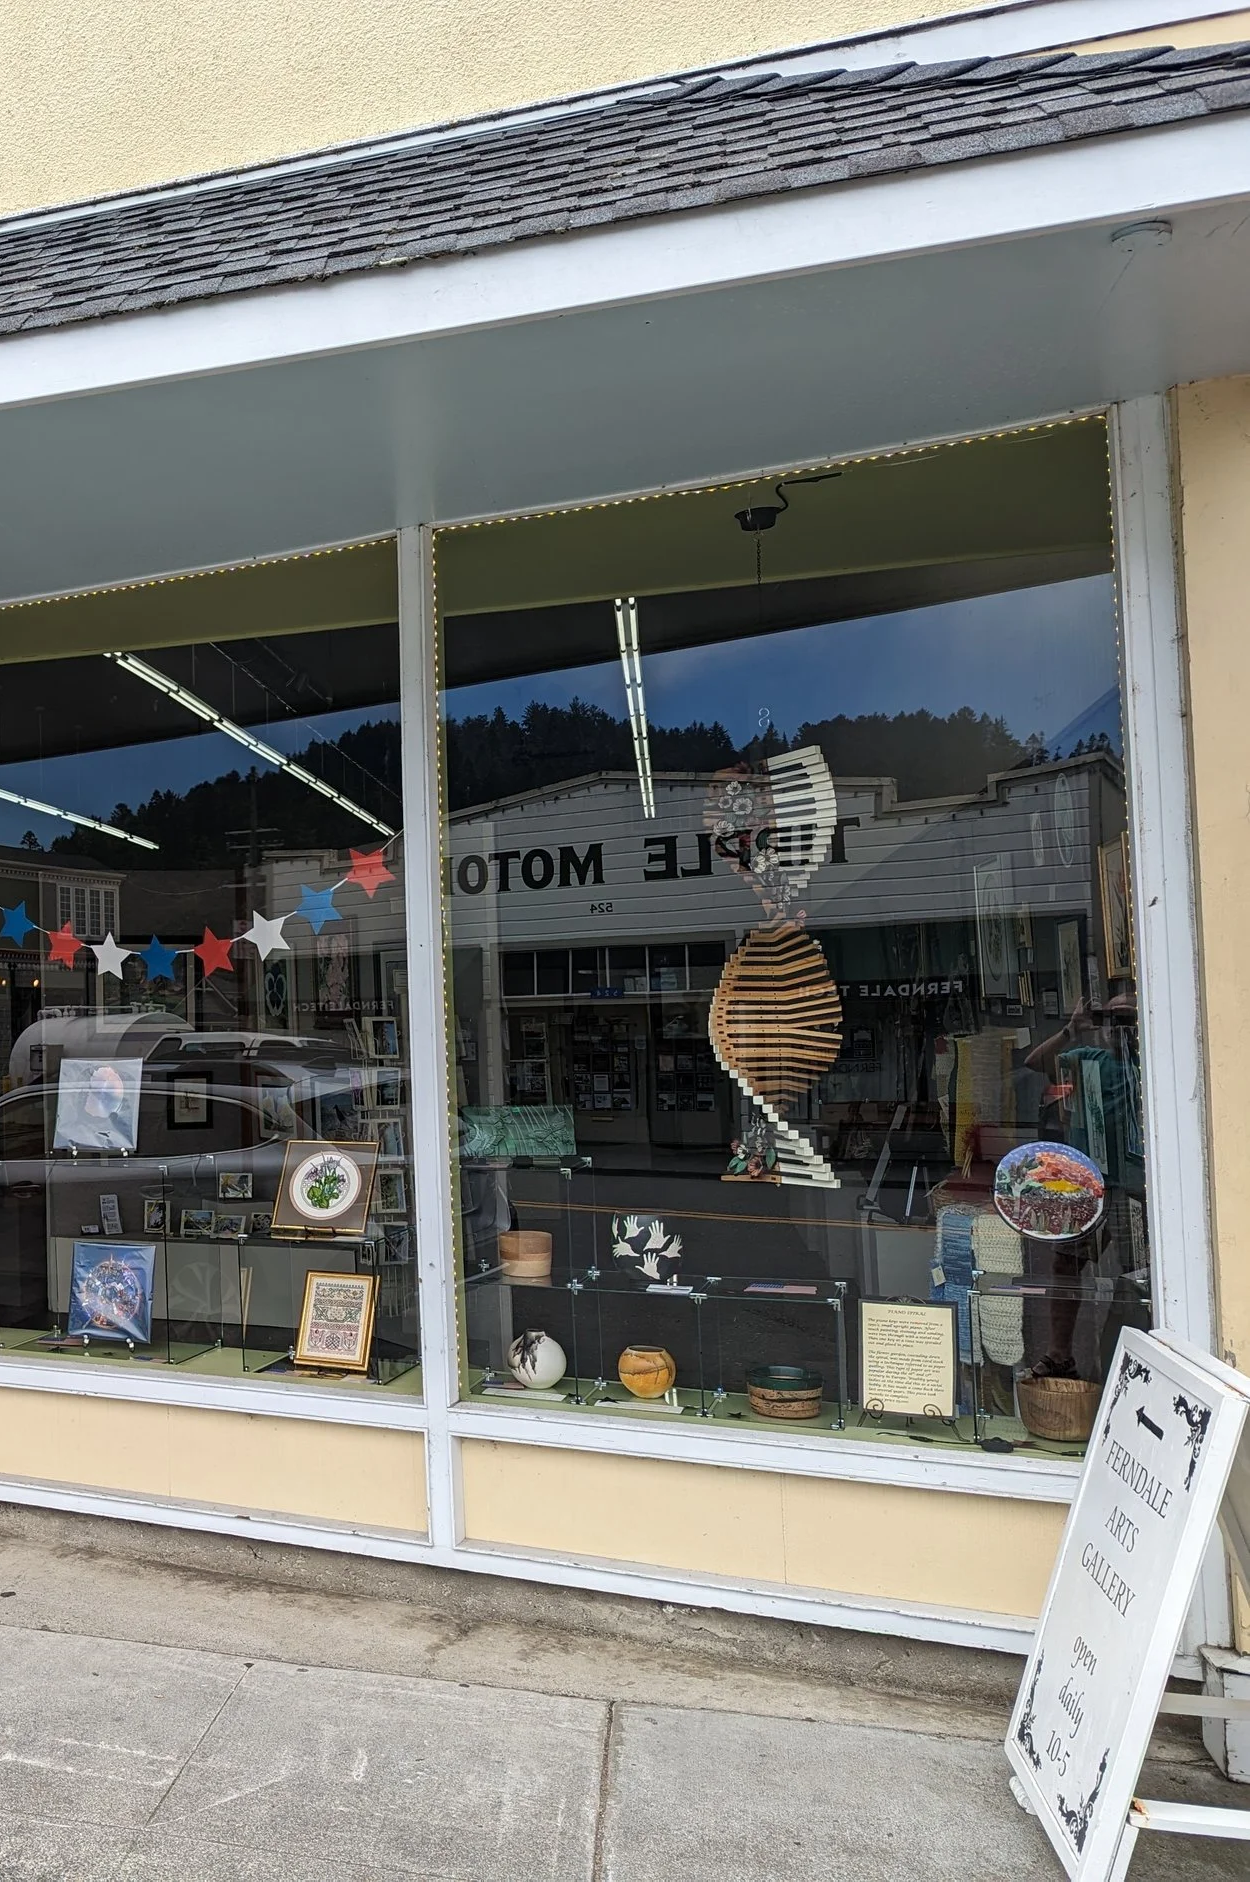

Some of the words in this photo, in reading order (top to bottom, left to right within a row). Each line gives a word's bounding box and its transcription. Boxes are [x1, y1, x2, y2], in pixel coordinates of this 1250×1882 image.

[1105, 1439, 1173, 1519] FERNDALE
[1104, 1505, 1139, 1553] ARTS
[1081, 1542, 1136, 1619] GALLERY
[1070, 1636, 1097, 1675] open
[1058, 1676, 1085, 1739] daily
[1046, 1730, 1071, 1777] 10-5
